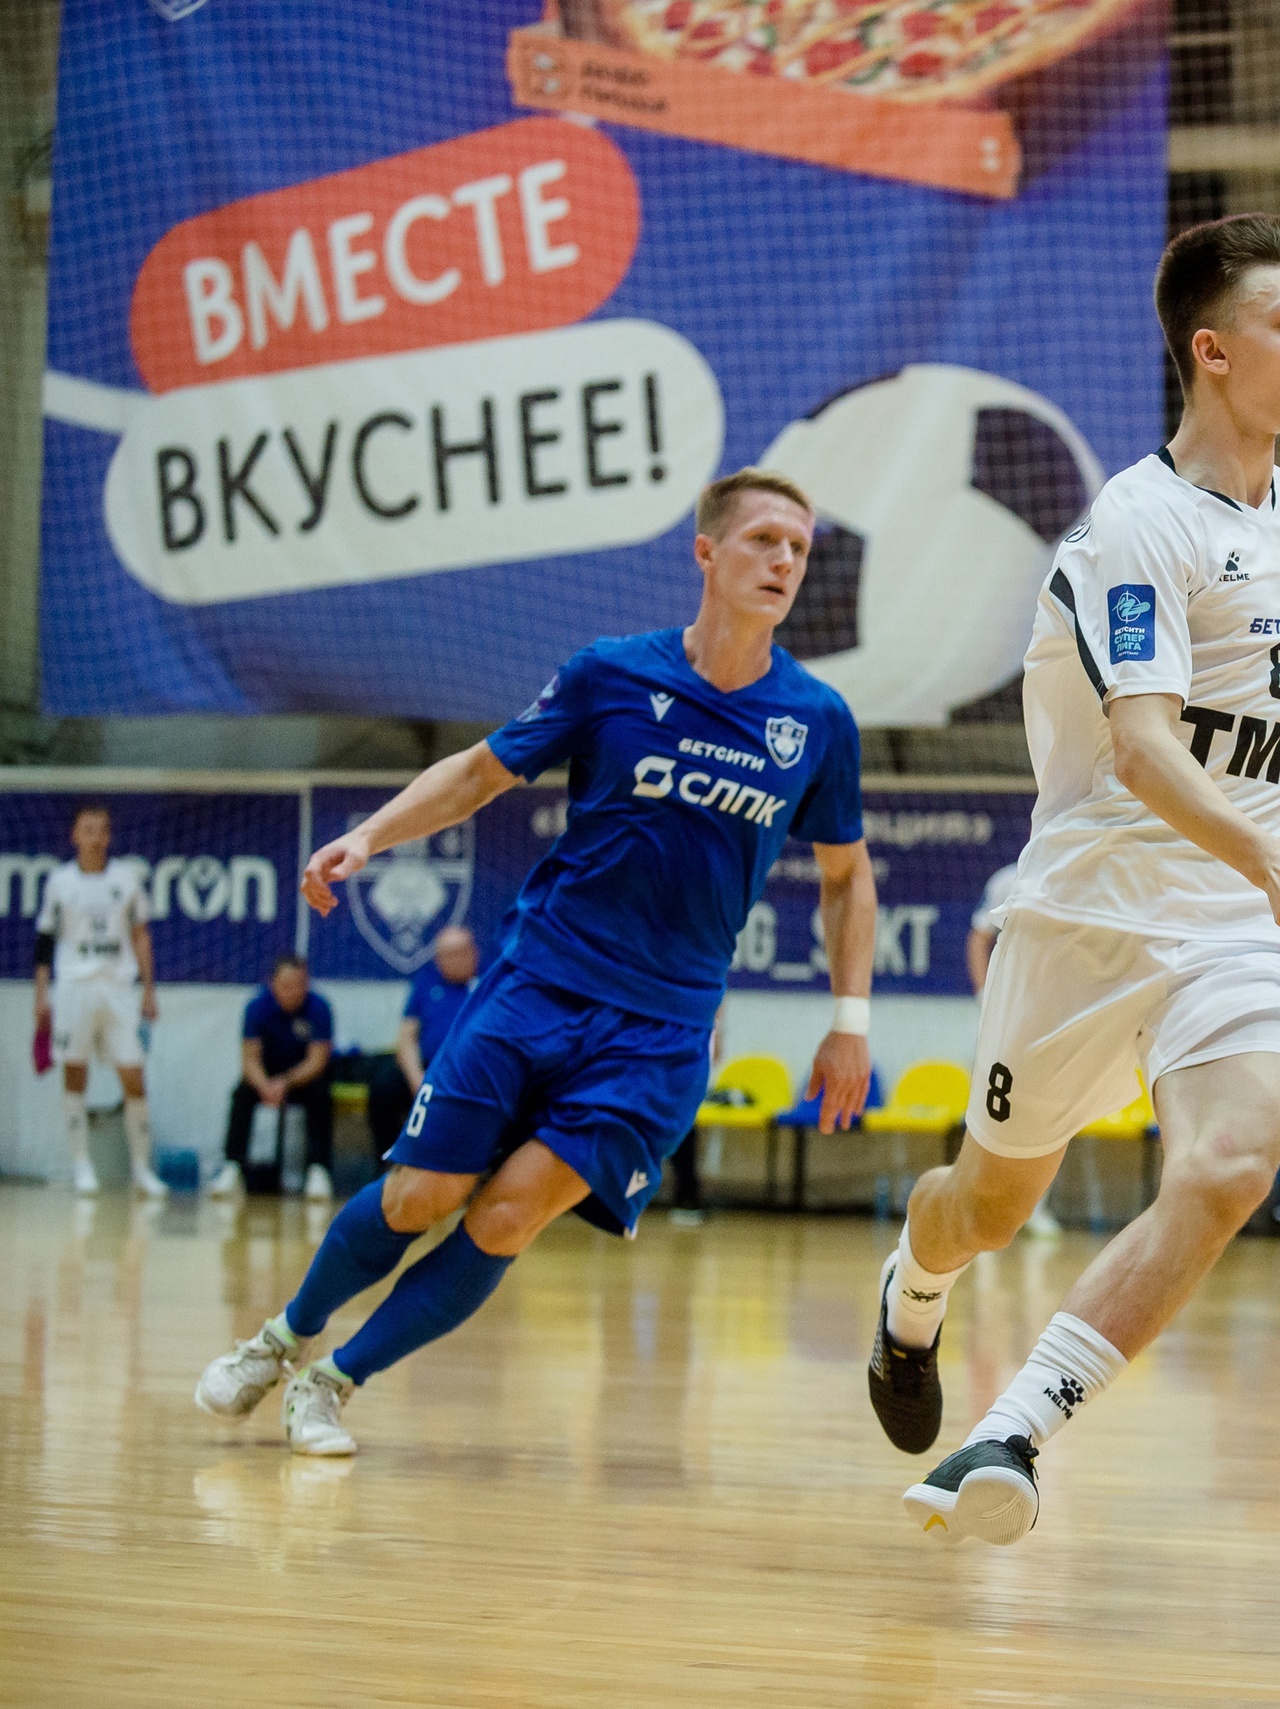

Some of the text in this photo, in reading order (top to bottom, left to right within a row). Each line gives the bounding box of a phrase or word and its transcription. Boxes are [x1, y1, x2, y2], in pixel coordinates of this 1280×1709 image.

[184, 160, 580, 365] ВМЕСТЕ
[156, 371, 668, 556] ВКУСНЕЕ!
[1114, 632, 1146, 645] СУПЕР
[1116, 641, 1142, 653] ЛИГА
[678, 737, 767, 773] БЕТСИТИ
[678, 771, 787, 828] СЛПК
[0, 853, 277, 923] mron
[406, 1082, 434, 1138] 6
[986, 1061, 1013, 1123] 8
